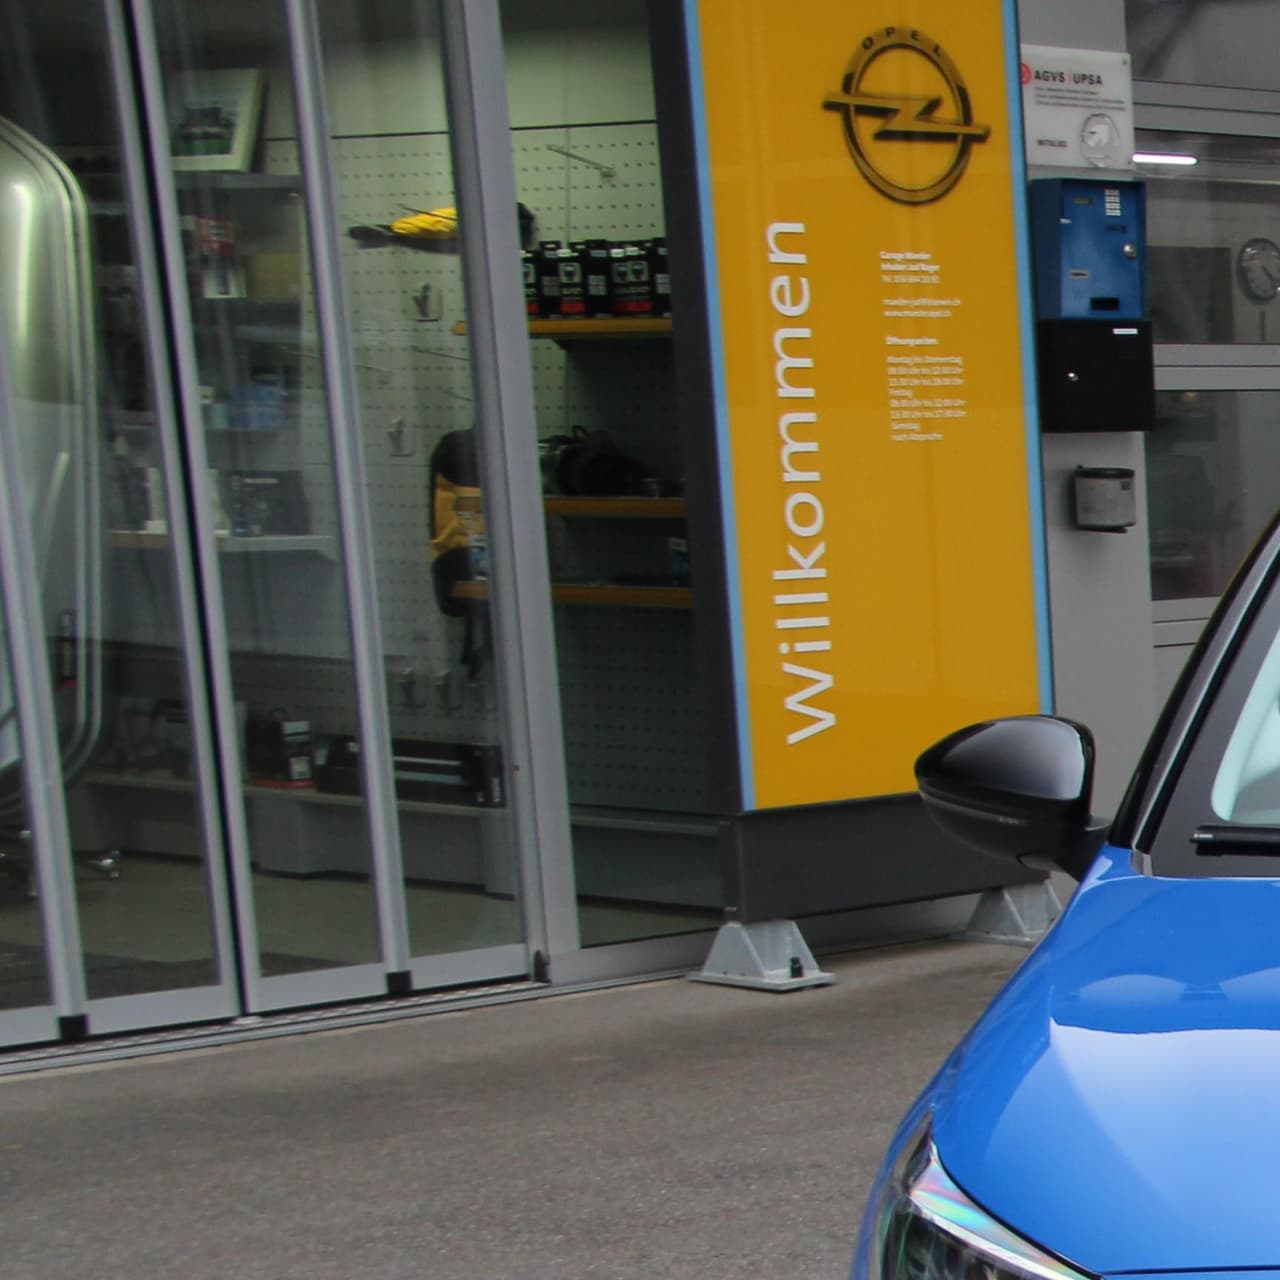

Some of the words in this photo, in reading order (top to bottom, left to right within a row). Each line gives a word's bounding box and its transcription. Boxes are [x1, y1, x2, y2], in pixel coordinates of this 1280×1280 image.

[861, 25, 943, 57] OPEL
[1034, 69, 1066, 83] AGVS
[1072, 72, 1104, 86] UPSA
[765, 220, 837, 746] Willkommen
